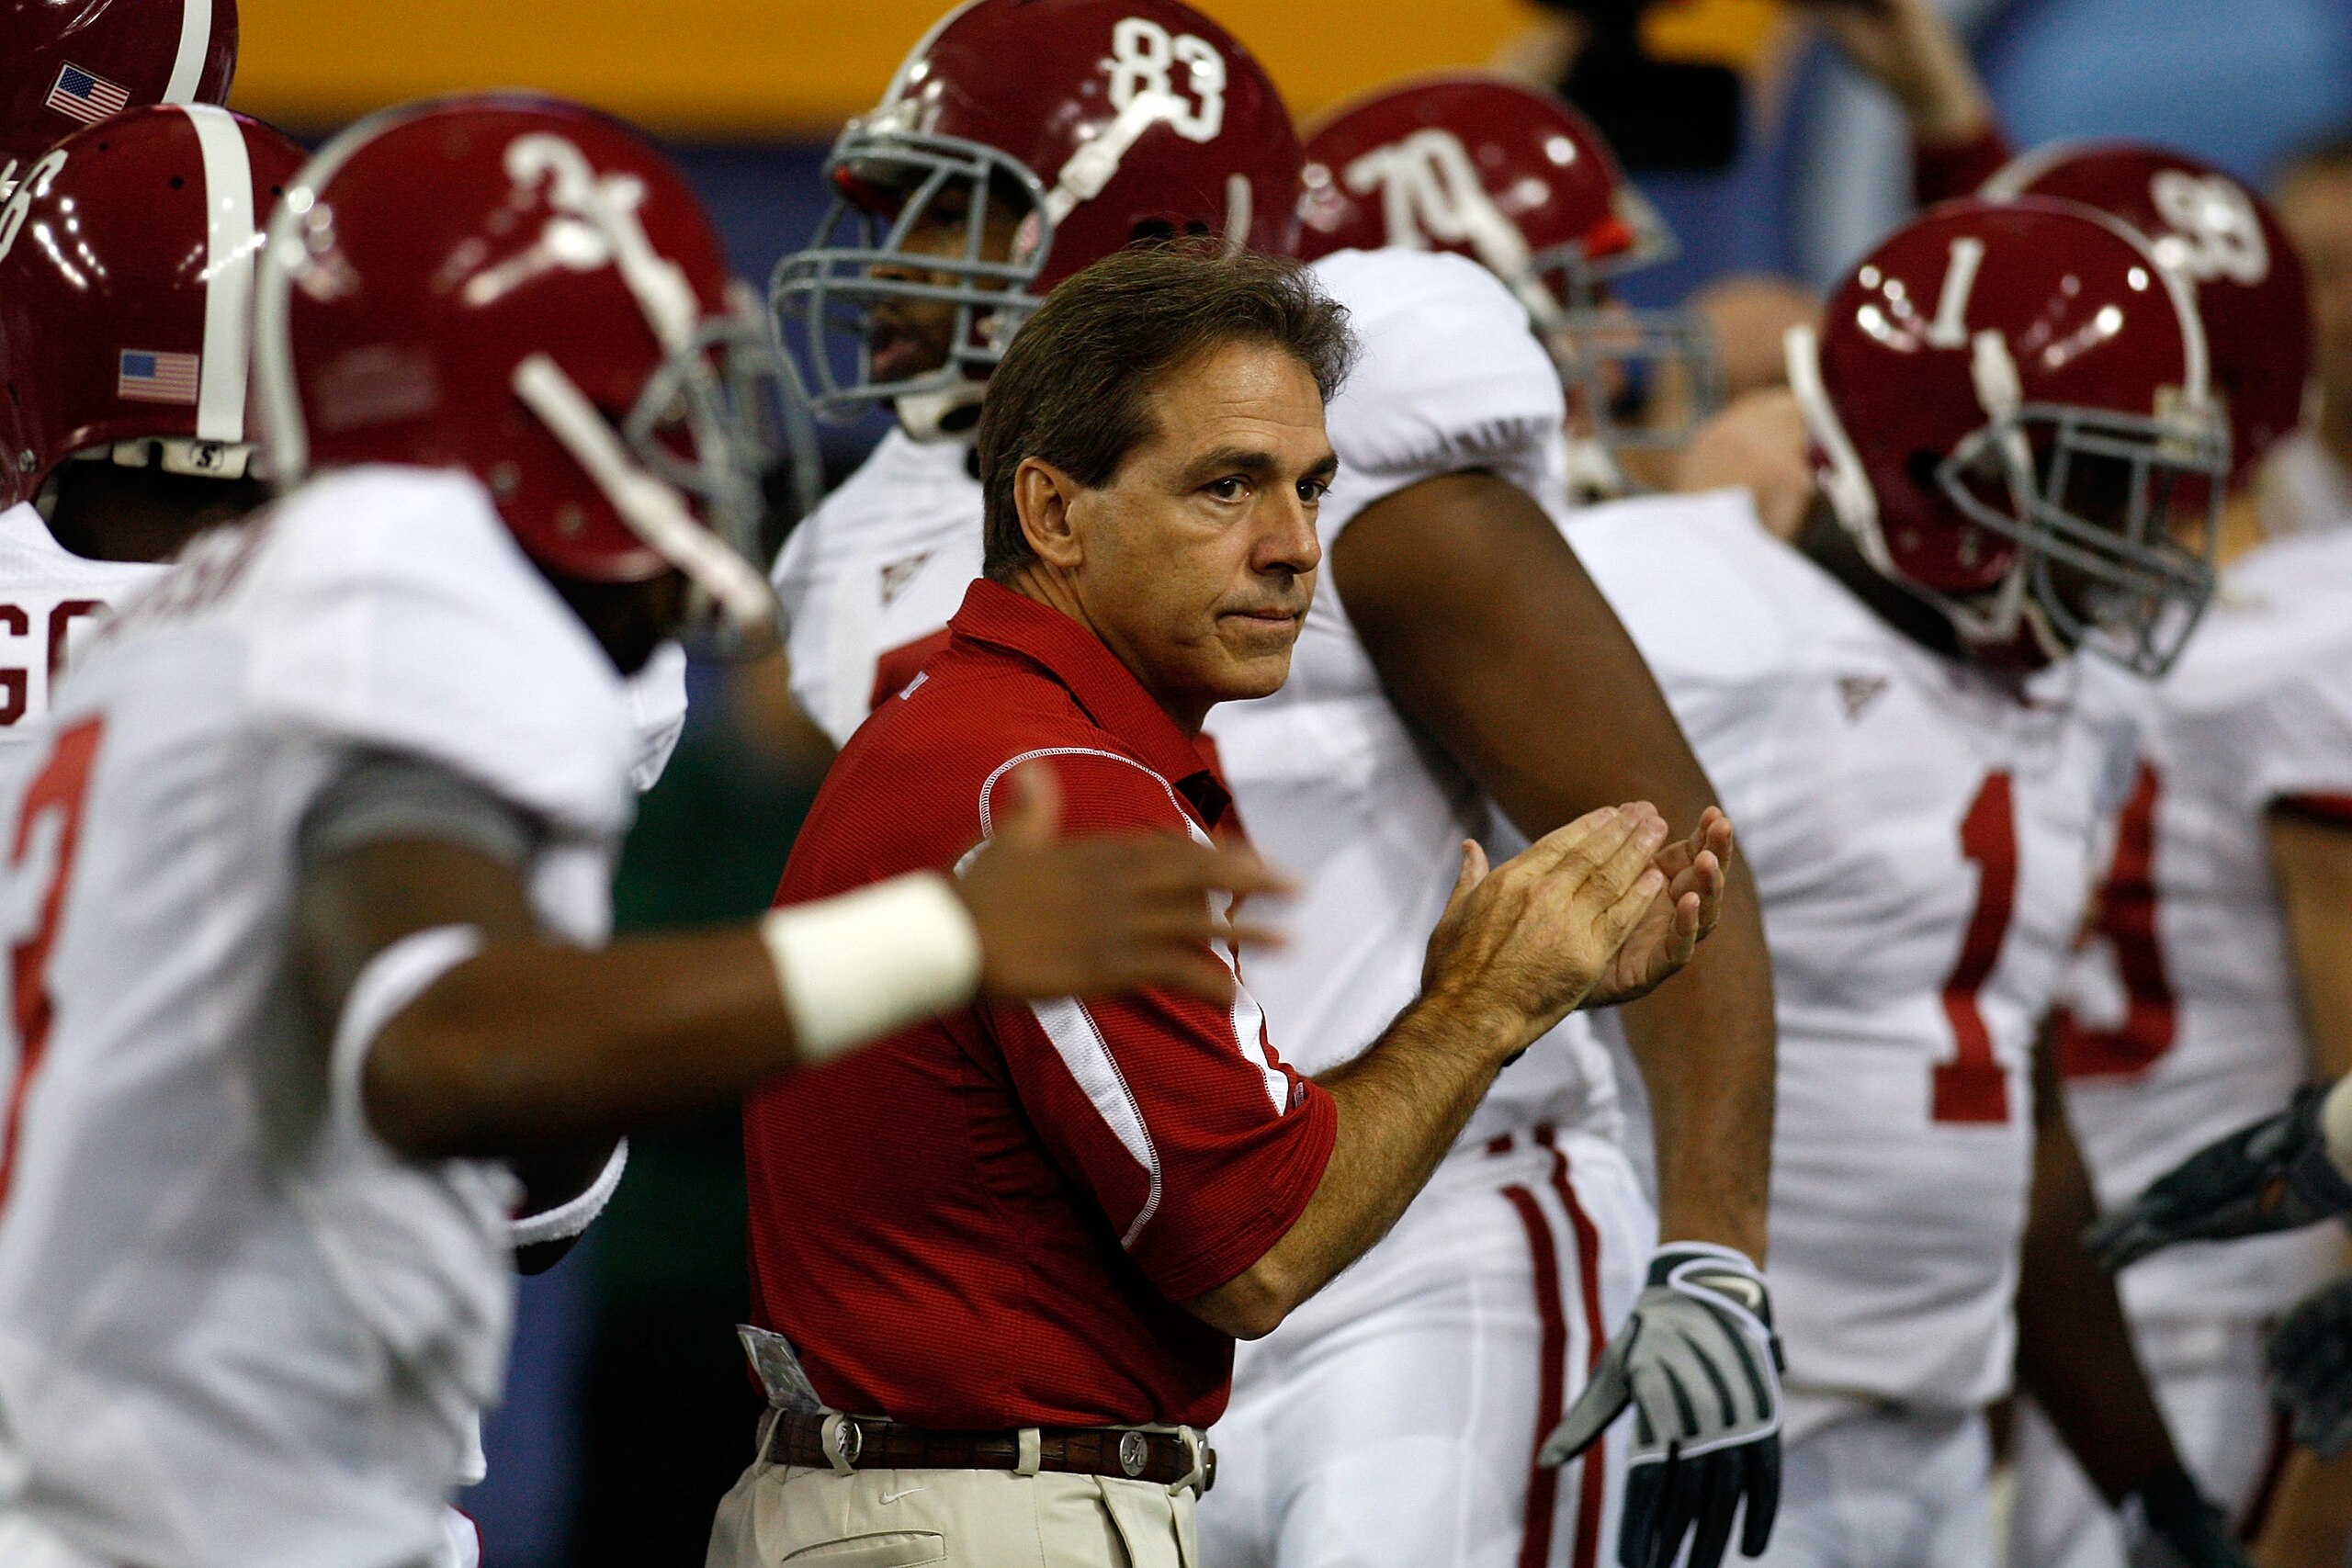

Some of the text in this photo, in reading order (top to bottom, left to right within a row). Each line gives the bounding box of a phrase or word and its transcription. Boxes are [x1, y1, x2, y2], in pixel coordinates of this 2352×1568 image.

[1109, 17, 1227, 143] 83
[1342, 128, 1483, 254] 70
[1926, 237, 1985, 350] 1
[1930, 770, 2018, 1124] 1
